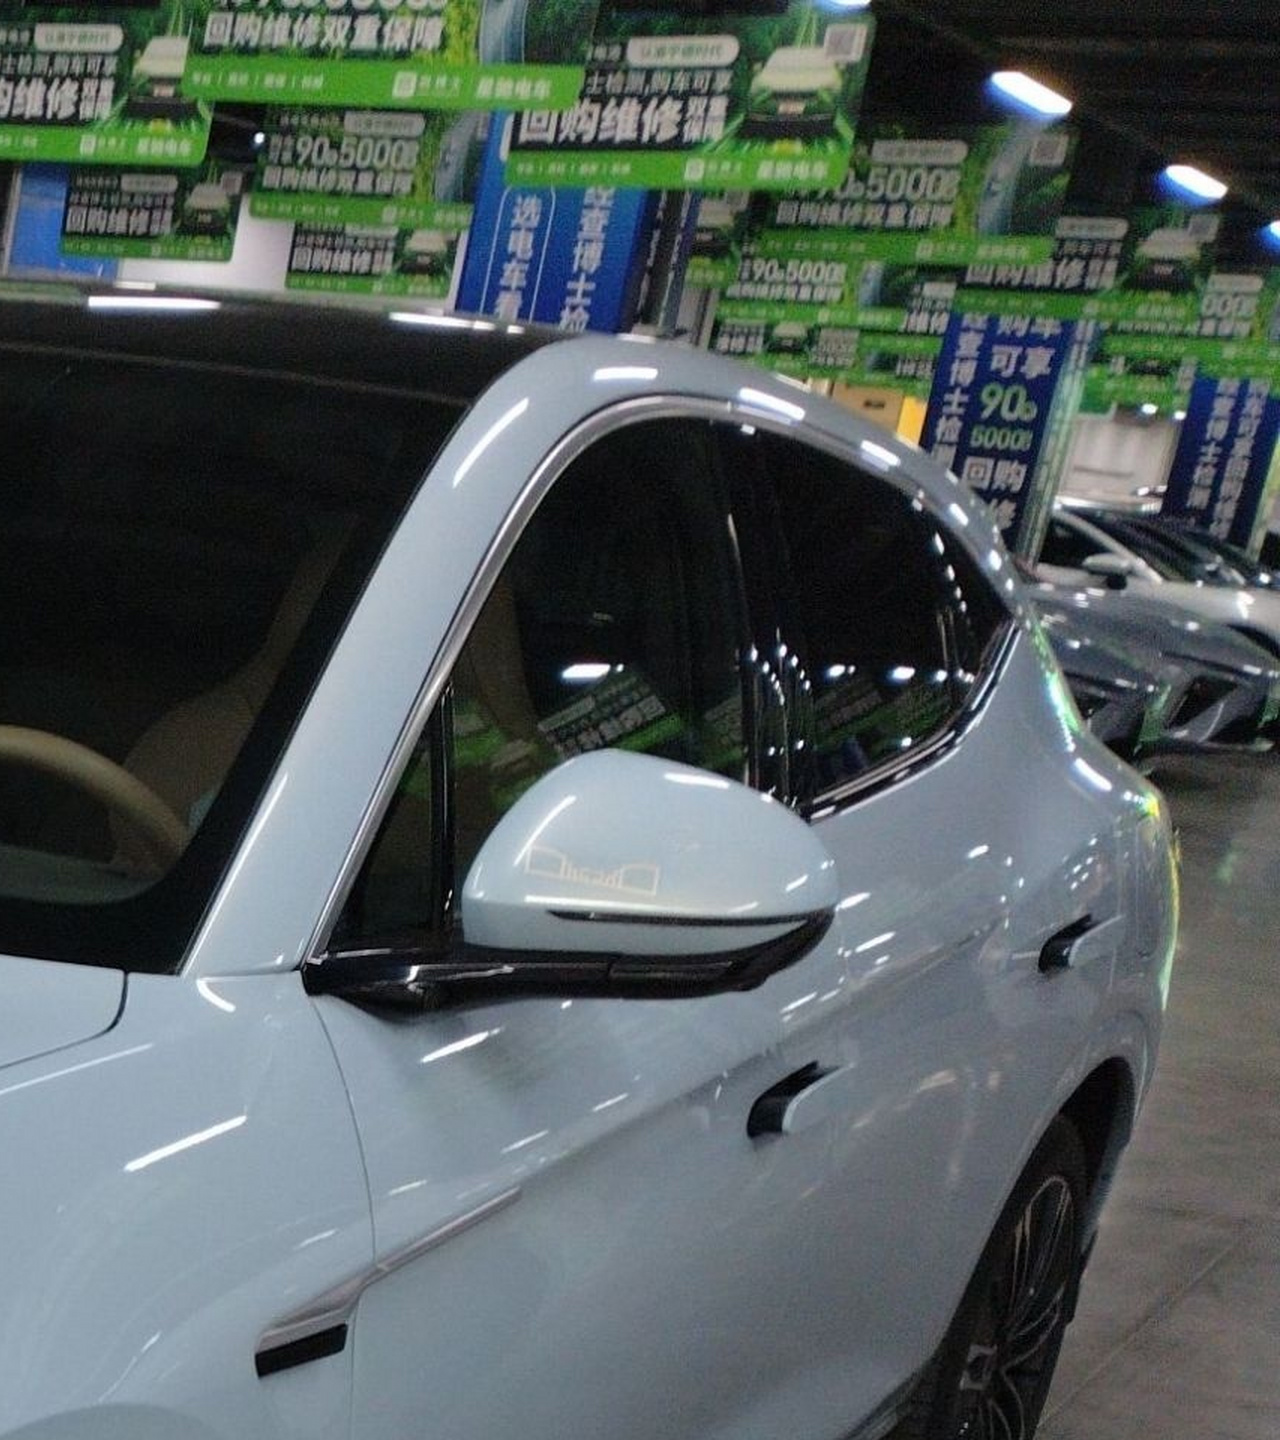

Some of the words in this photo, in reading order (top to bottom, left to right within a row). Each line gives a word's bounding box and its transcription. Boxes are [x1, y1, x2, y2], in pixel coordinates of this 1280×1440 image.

[203, 11, 445, 52] 回购维修双重保障
[518, 99, 683, 144] 回购维修
[989, 345, 1056, 380] 可享
[961, 456, 1029, 494] 回购
